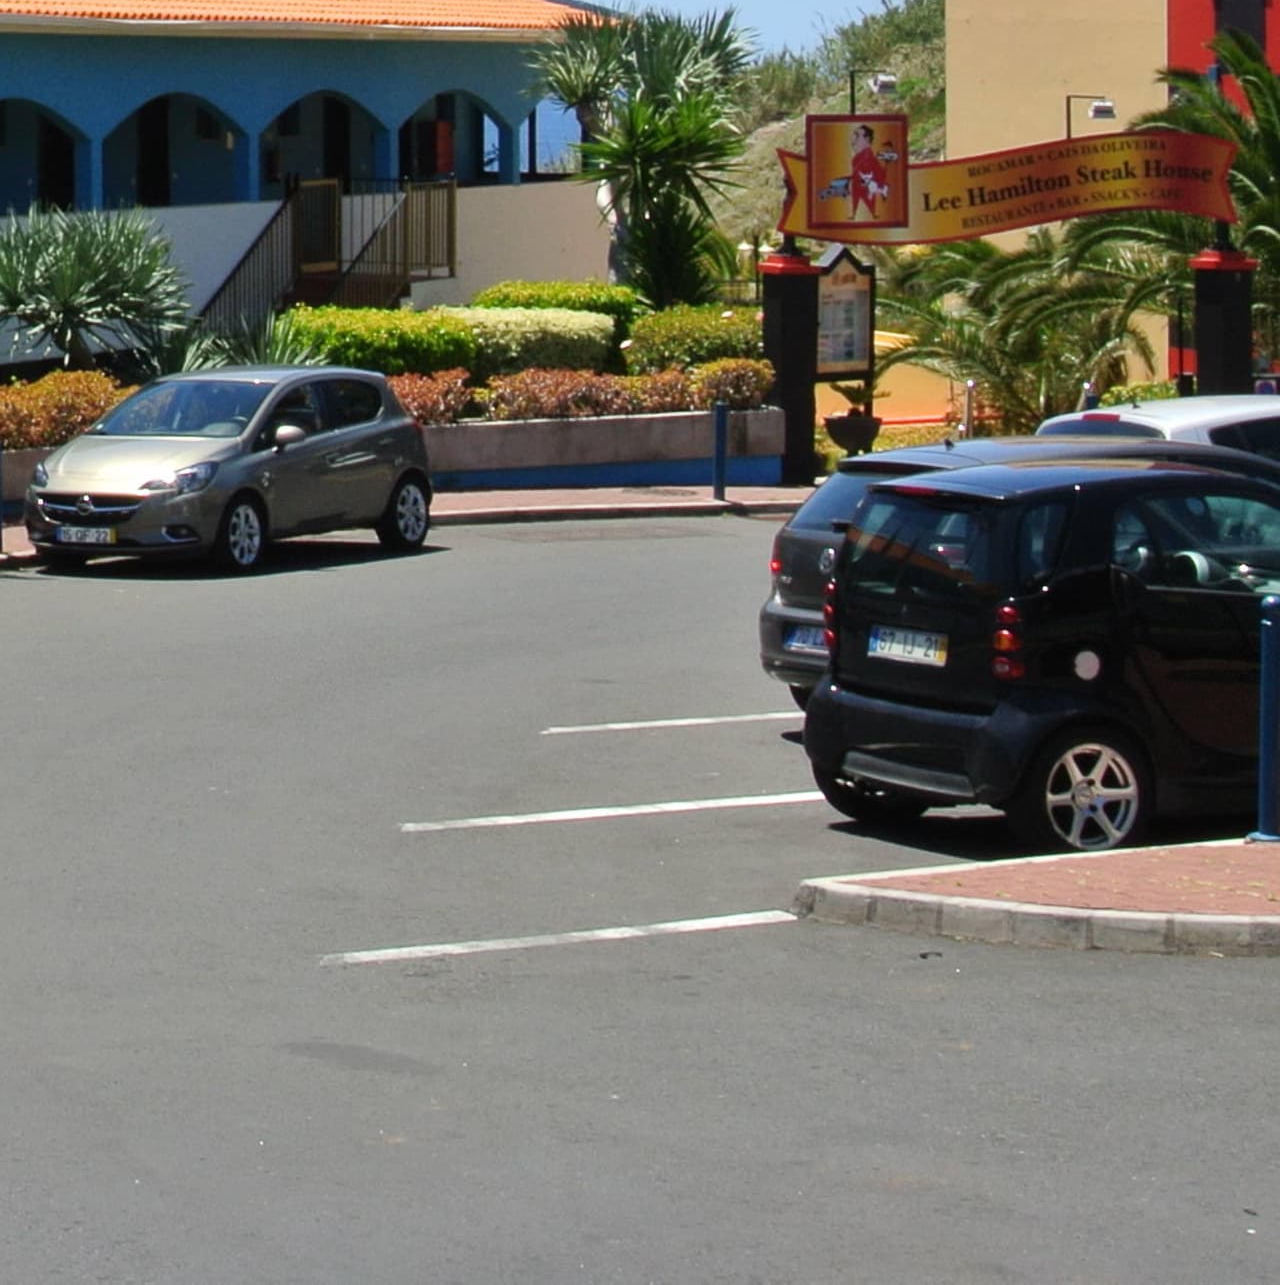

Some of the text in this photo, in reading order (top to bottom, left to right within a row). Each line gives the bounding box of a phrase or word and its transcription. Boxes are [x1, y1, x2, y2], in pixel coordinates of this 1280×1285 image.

[922, 159, 1213, 212] Lee Hamilton Steak House
